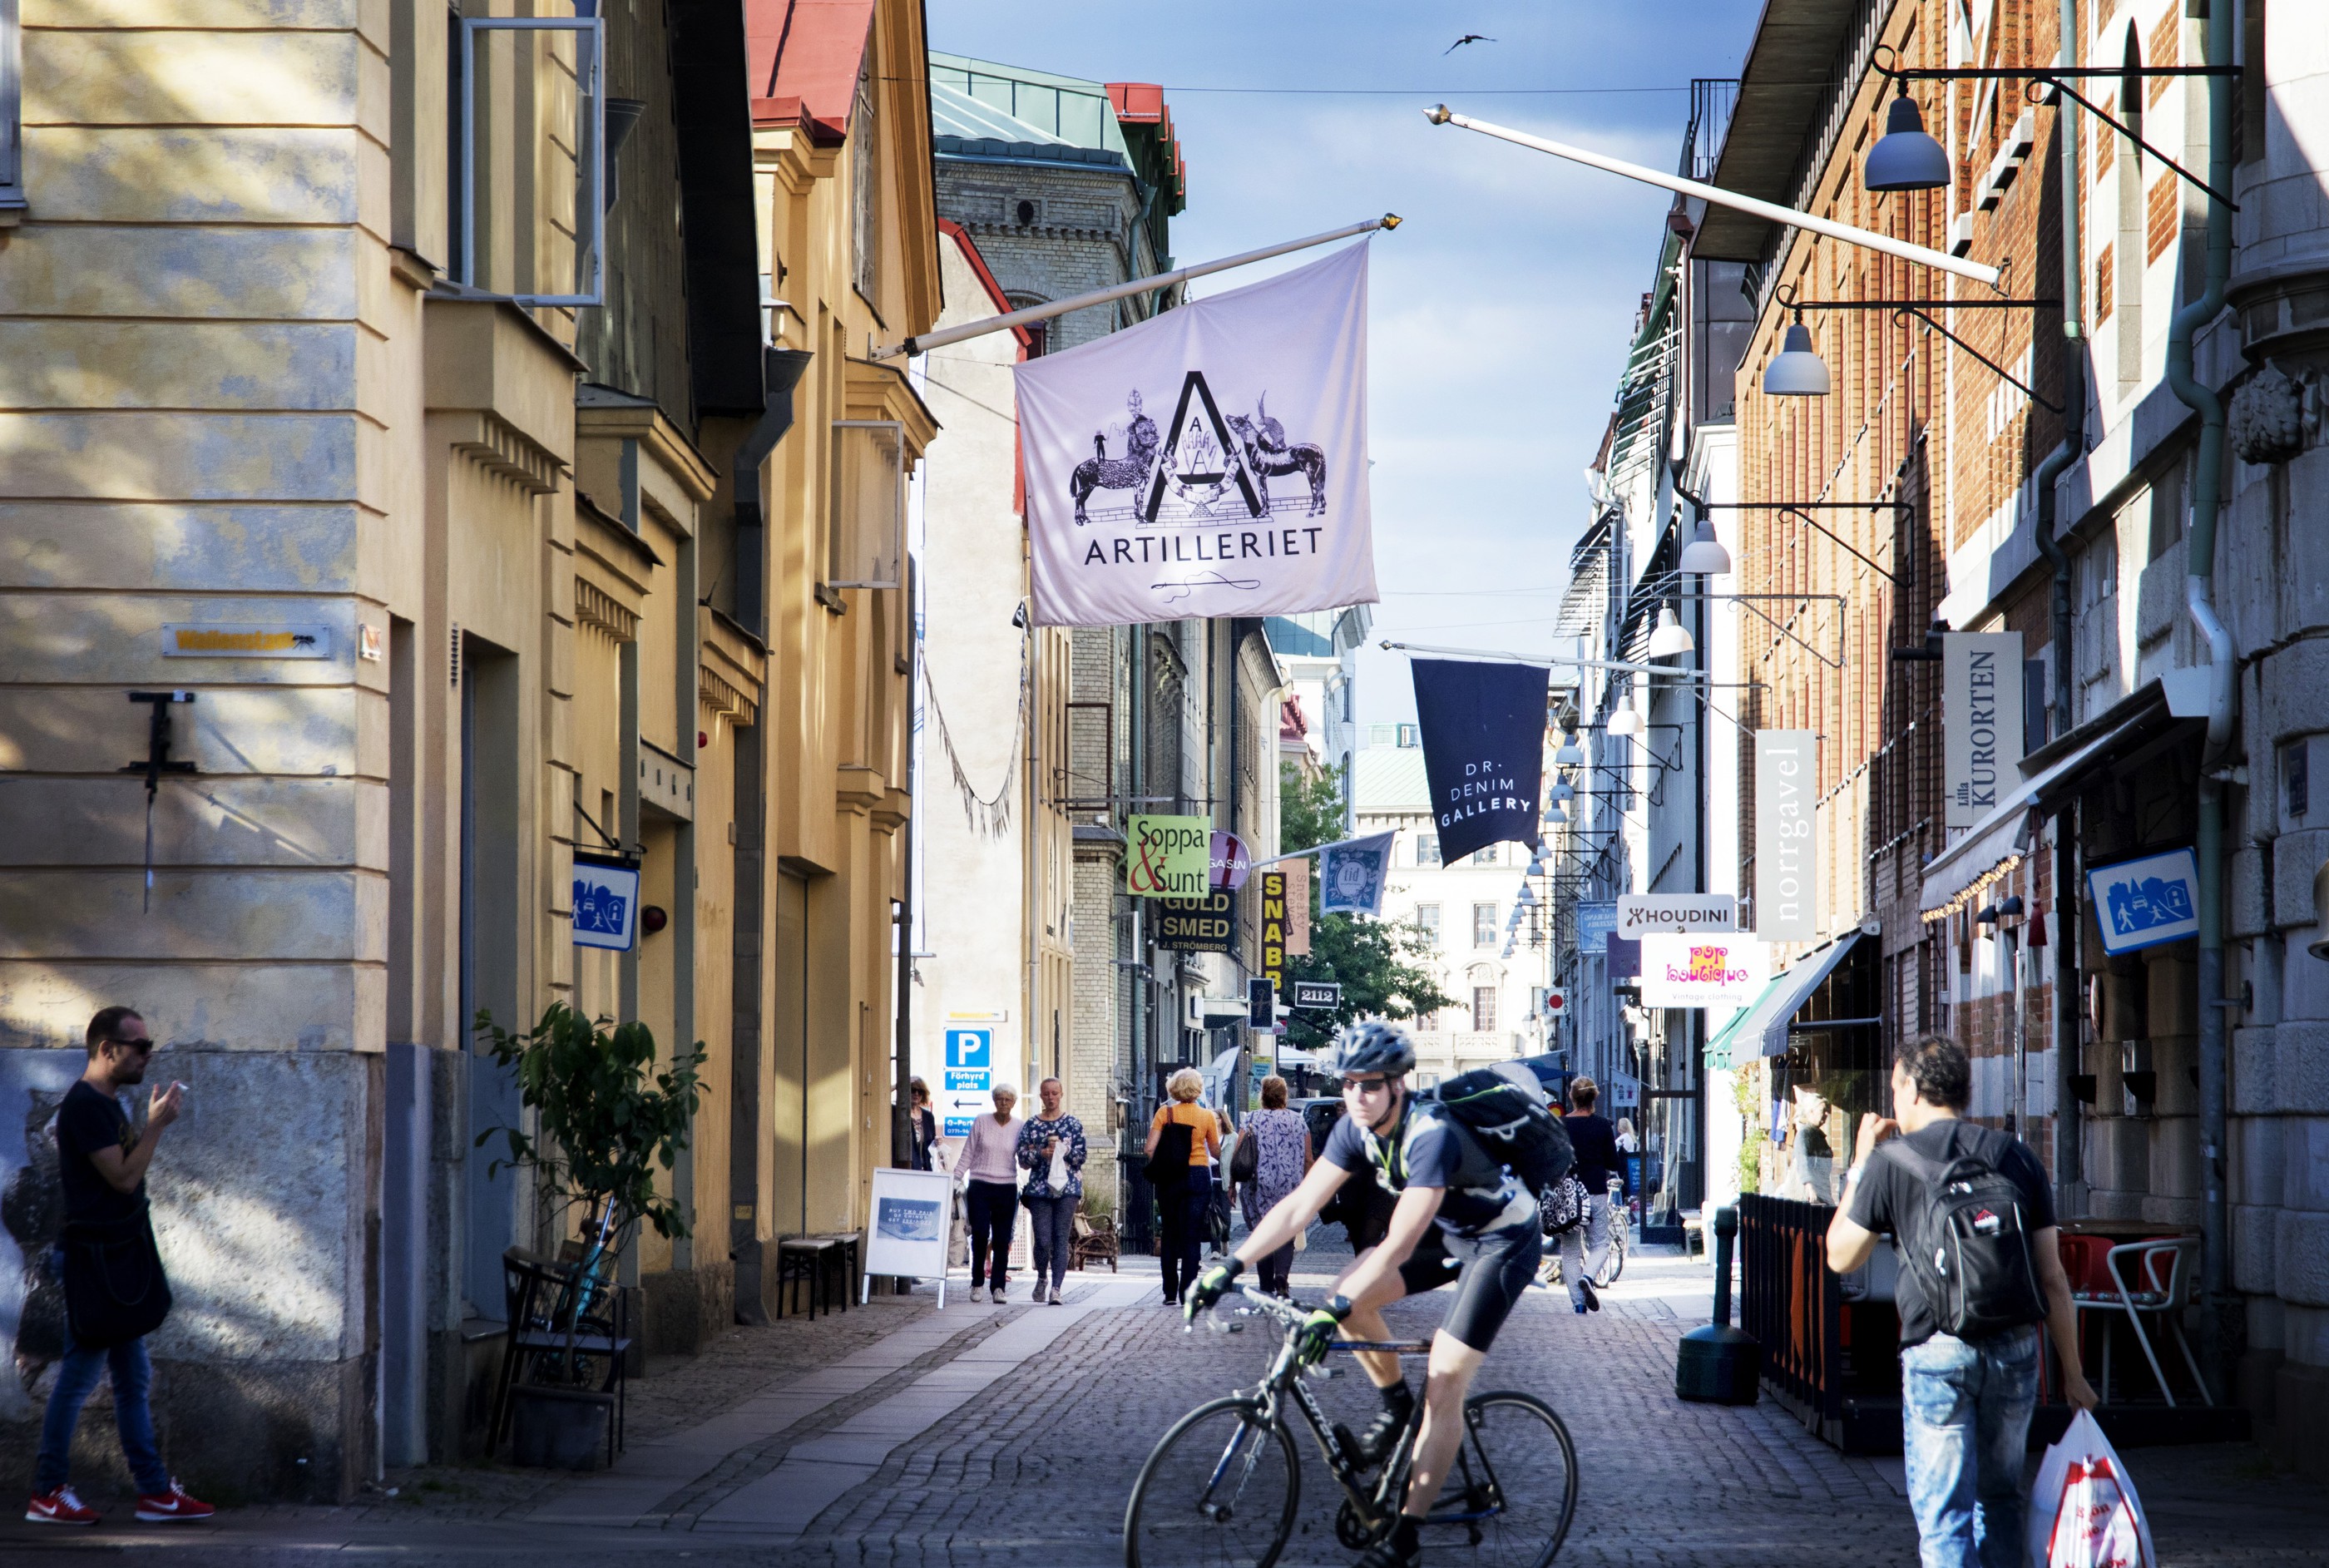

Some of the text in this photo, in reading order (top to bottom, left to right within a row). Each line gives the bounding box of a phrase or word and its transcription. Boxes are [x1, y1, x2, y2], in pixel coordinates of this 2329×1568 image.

[1085, 527, 1323, 566] ARTILLERIET
[1971, 650, 1996, 809] KURORTEN
[1451, 778, 1514, 801] DENIM
[1957, 782, 1970, 807] Lilla
[1441, 797, 1530, 828] GALLERY
[1137, 820, 1204, 854] Soppa
[1765, 747, 1810, 922] norrgavel
[1209, 858, 1247, 869] GASIN
[1154, 864, 1204, 893] Sunt
[1164, 894, 1229, 912] GULD
[1164, 917, 1229, 937] SMED
[1646, 909, 1728, 923] HOUDINI
[1263, 875, 1283, 990] SNABB
[1172, 941, 1228, 951] STRÖMBERG
[1666, 964, 1748, 987] boutique
[1301, 990, 1333, 1002] 2112
[958, 1033, 982, 1065] P
[951, 1071, 984, 1081] Förhyrd
[957, 1081, 978, 1090] plats
